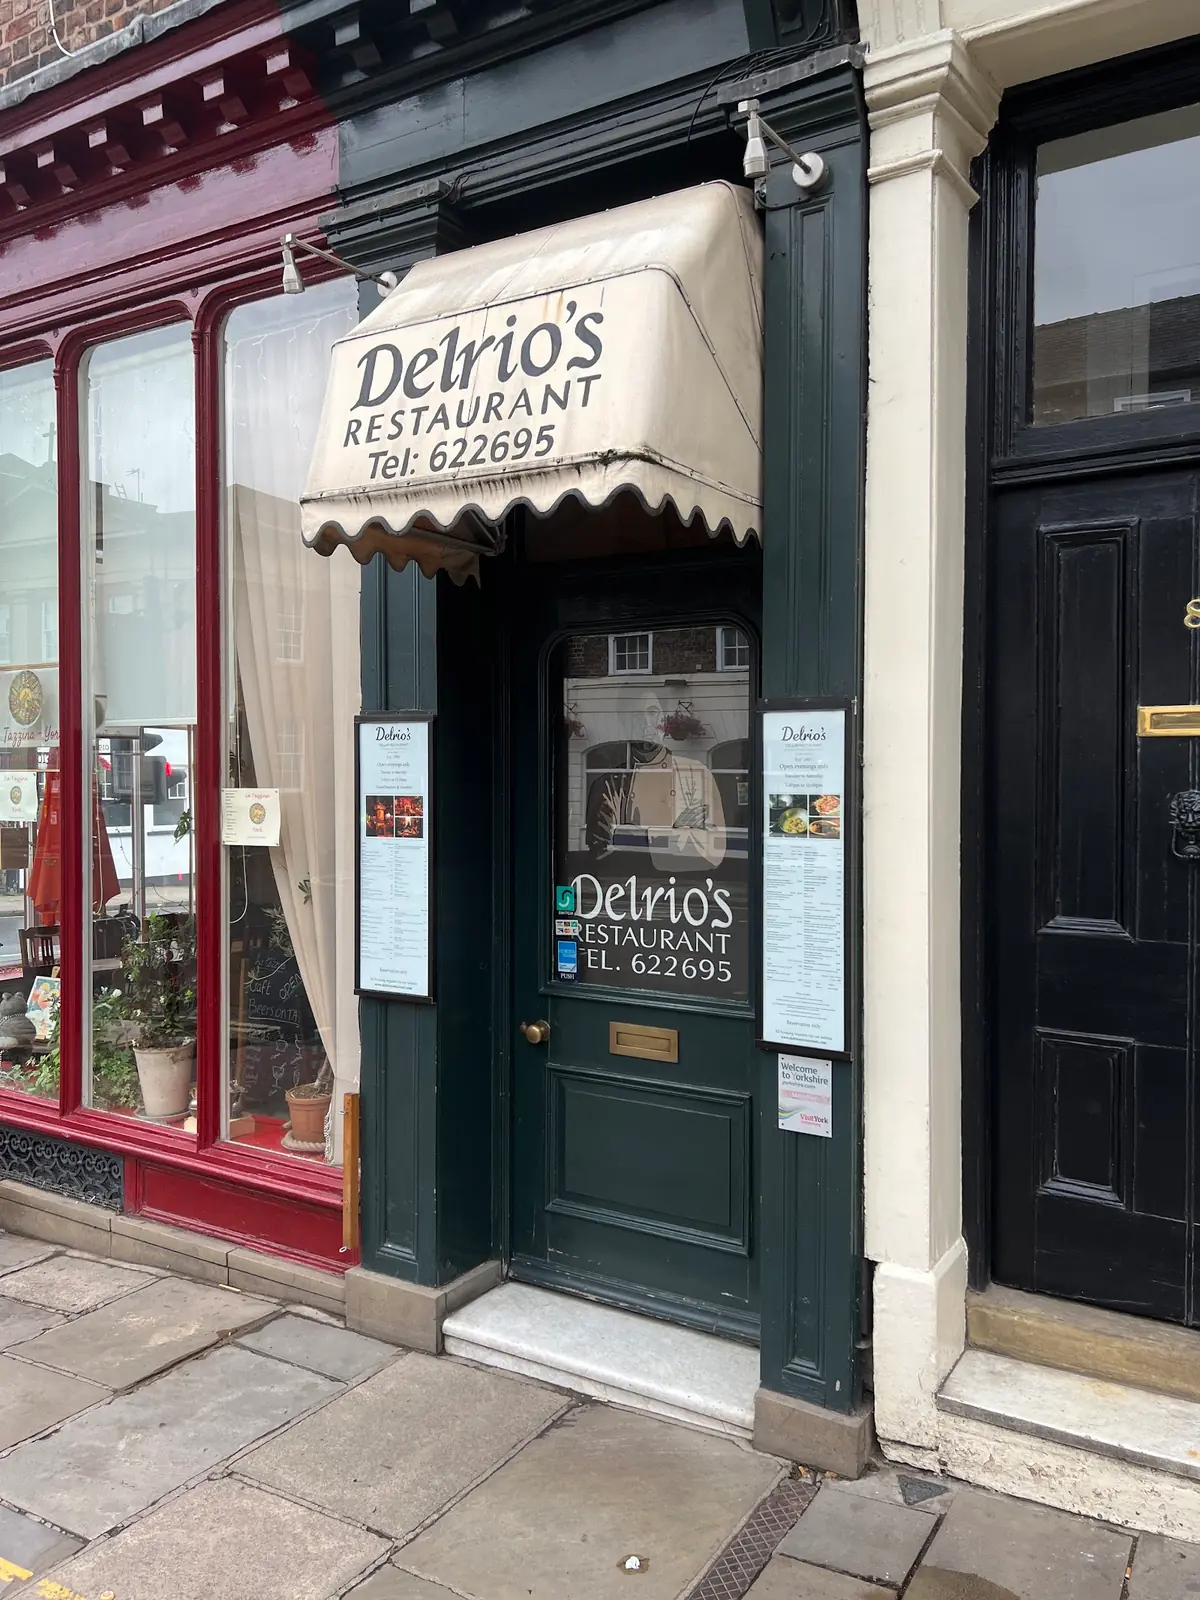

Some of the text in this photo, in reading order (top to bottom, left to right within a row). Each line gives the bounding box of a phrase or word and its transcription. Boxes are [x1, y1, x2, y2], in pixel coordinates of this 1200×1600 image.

[350, 300, 604, 411] Delrio's
[343, 373, 602, 447] RESTAURANT
[368, 424, 555, 479] Tel: 622695
[4, 726, 36, 747] Tazzina
[44, 724, 59, 742] Yor
[375, 726, 411, 741] Delrio's
[781, 726, 826, 741] Delrio's
[571, 873, 733, 928] Delrio's
[560, 972, 575, 980] PUSH
[631, 953, 732, 982] 622695
[780, 1061, 818, 1075] Welcome
[782, 1071, 829, 1086] to Yorkshire
